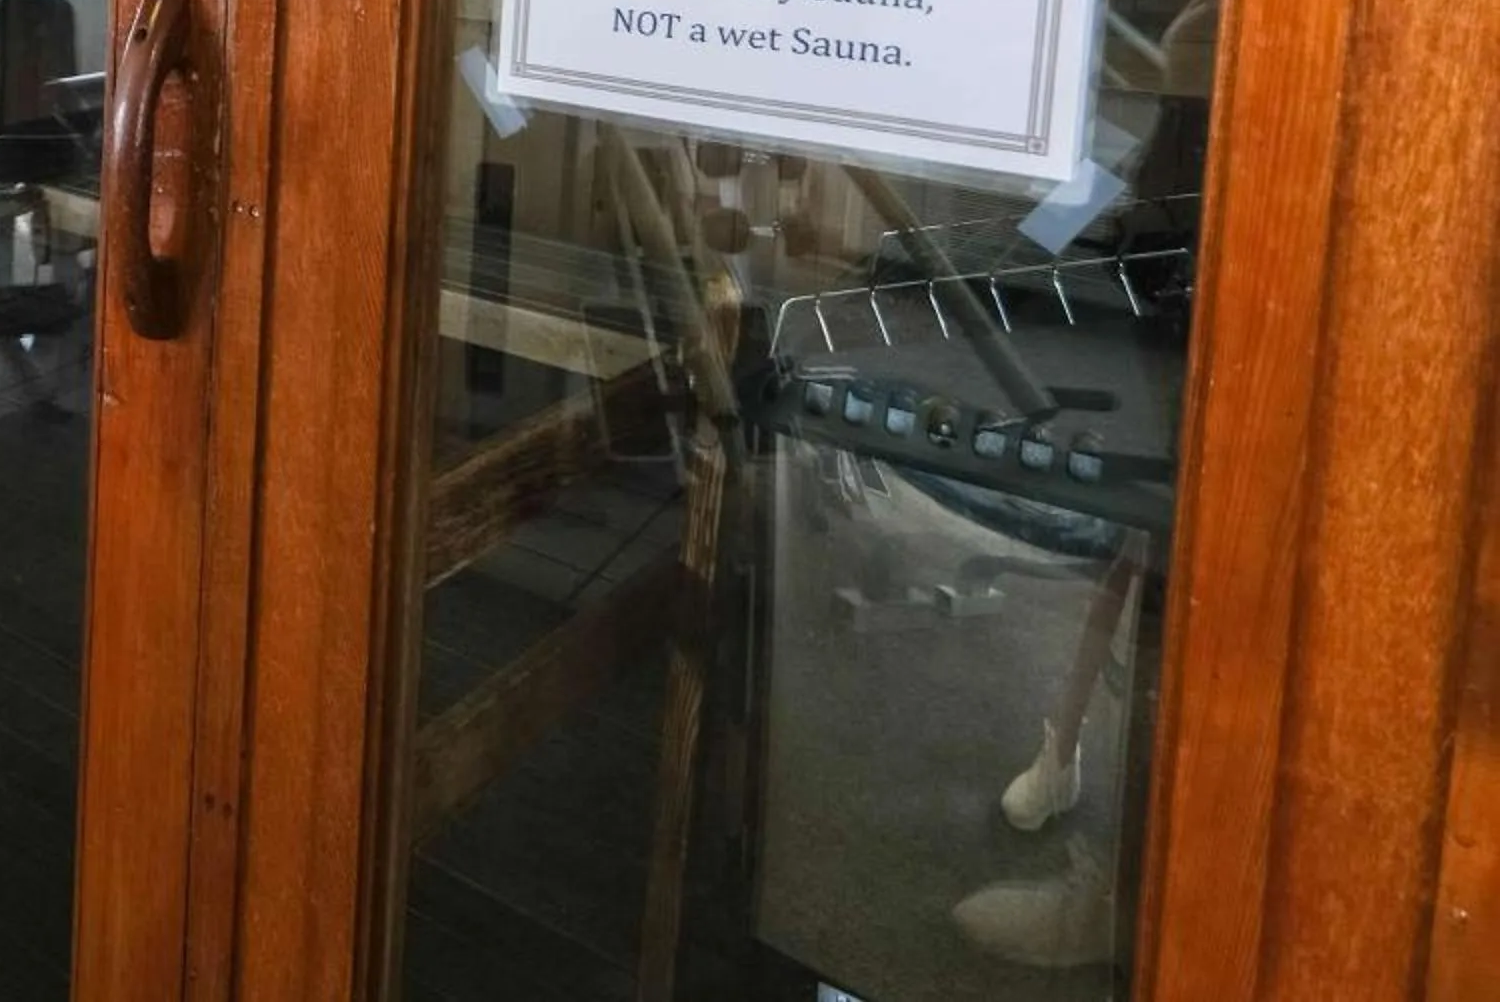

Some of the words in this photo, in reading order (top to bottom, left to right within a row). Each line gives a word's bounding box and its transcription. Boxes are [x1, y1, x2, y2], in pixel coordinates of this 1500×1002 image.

[612, 7, 681, 39] NOT
[689, 21, 707, 43] a
[717, 24, 782, 52] wet
[791, 26, 912, 67] Sauna.
